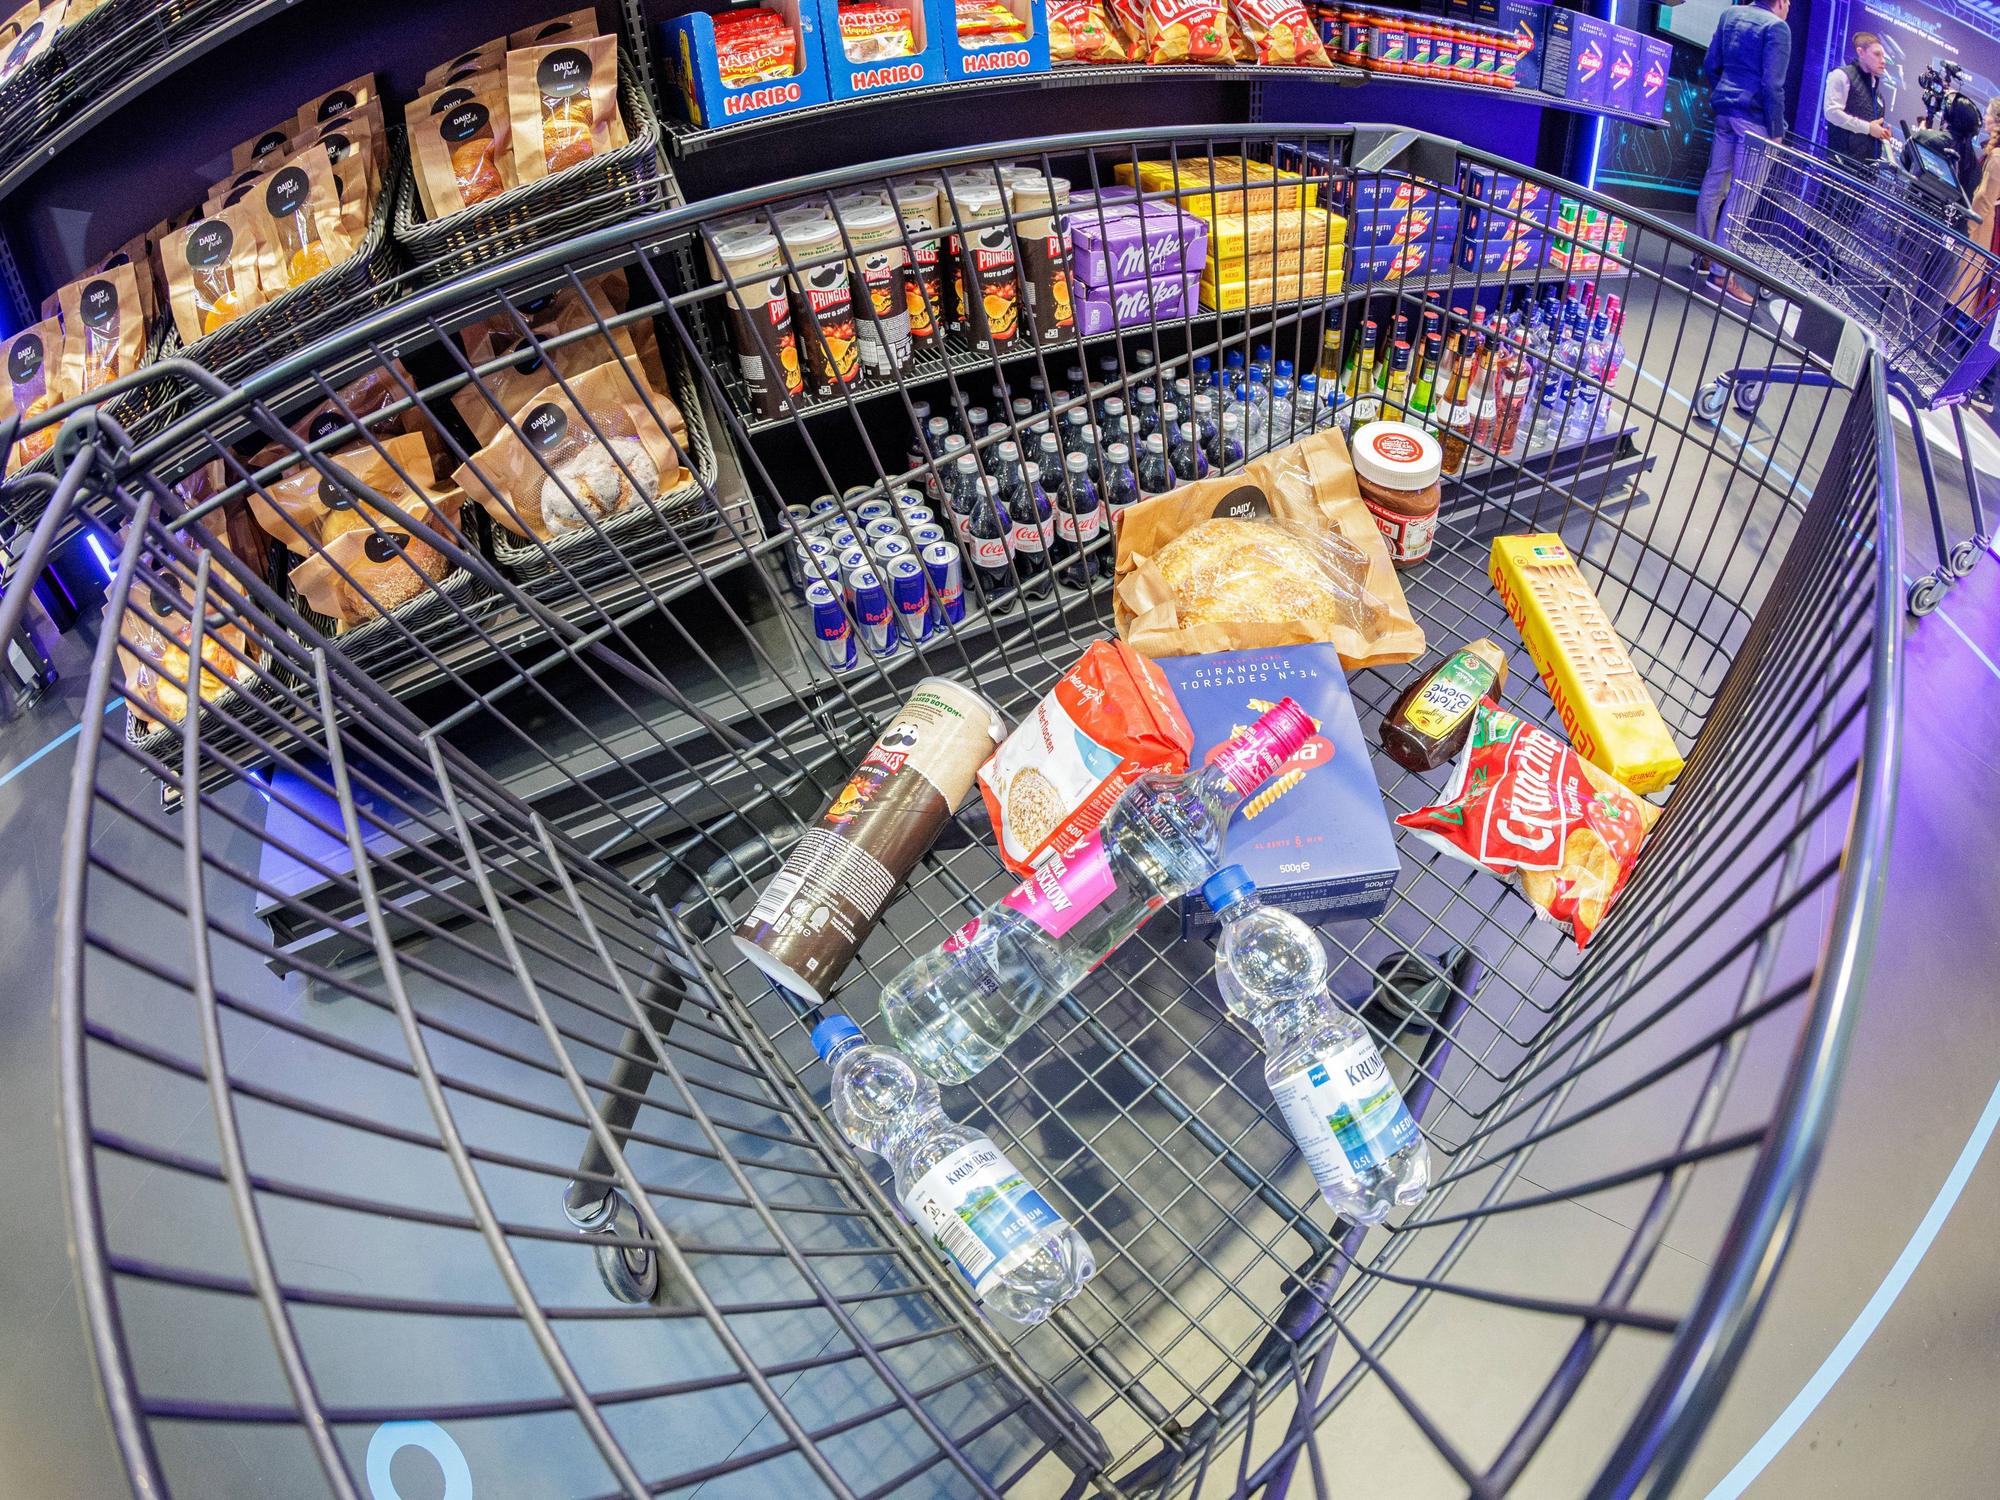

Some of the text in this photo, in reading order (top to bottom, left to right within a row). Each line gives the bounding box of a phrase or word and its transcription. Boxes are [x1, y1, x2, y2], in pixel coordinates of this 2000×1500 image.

[1063, 9, 1085, 22] Paprika
[1188, 12, 1212, 25] Paprika
[1894, 20, 1917, 34] platform
[1944, 43, 1959, 55] carts
[553, 60, 574, 72] DAILY
[757, 57, 778, 69] Cola
[962, 49, 1031, 73] HARIBO
[850, 63, 925, 91] HARIBO
[724, 83, 802, 117] HARIBO
[328, 101, 345, 114] DAILY
[453, 112, 472, 125] DAILY
[260, 140, 276, 153] DAILY
[277, 179, 294, 195] DAILY
[199, 233, 217, 246] DAILY
[1360, 261, 1387, 269] SPAHETTI
[865, 268, 892, 281] PRINGLES
[90, 290, 105, 303] DAILY
[817, 312, 831, 320] HOT
[17, 347, 32, 360] DAILY
[531, 413, 548, 430] DAILY
[318, 422, 333, 436] DAILY
[1230, 502, 1251, 516] DAILY
[903, 600, 921, 612] Red
[1494, 566, 1527, 634] KEKS
[866, 611, 884, 623] Red
[824, 624, 843, 638] Red
[1196, 660, 1291, 678] GIRANDOLE
[1181, 673, 1267, 690] TORSADES
[1423, 690, 1460, 714] Flotte
[1432, 682, 1473, 709] Biene
[1542, 661, 1596, 761] LEIBNIZ
[1612, 709, 1645, 720] ORIGINAL
[867, 748, 904, 772] PRINGLES
[873, 769, 889, 778] SPICY
[1496, 729, 1563, 853] Crunchip
[1565, 775, 1579, 816] Paprika
[1065, 824, 1083, 838] 500
[1279, 863, 1301, 874] 500g
[1364, 879, 1384, 889] 500g
[1002, 1206, 1044, 1239] MEDIUM
